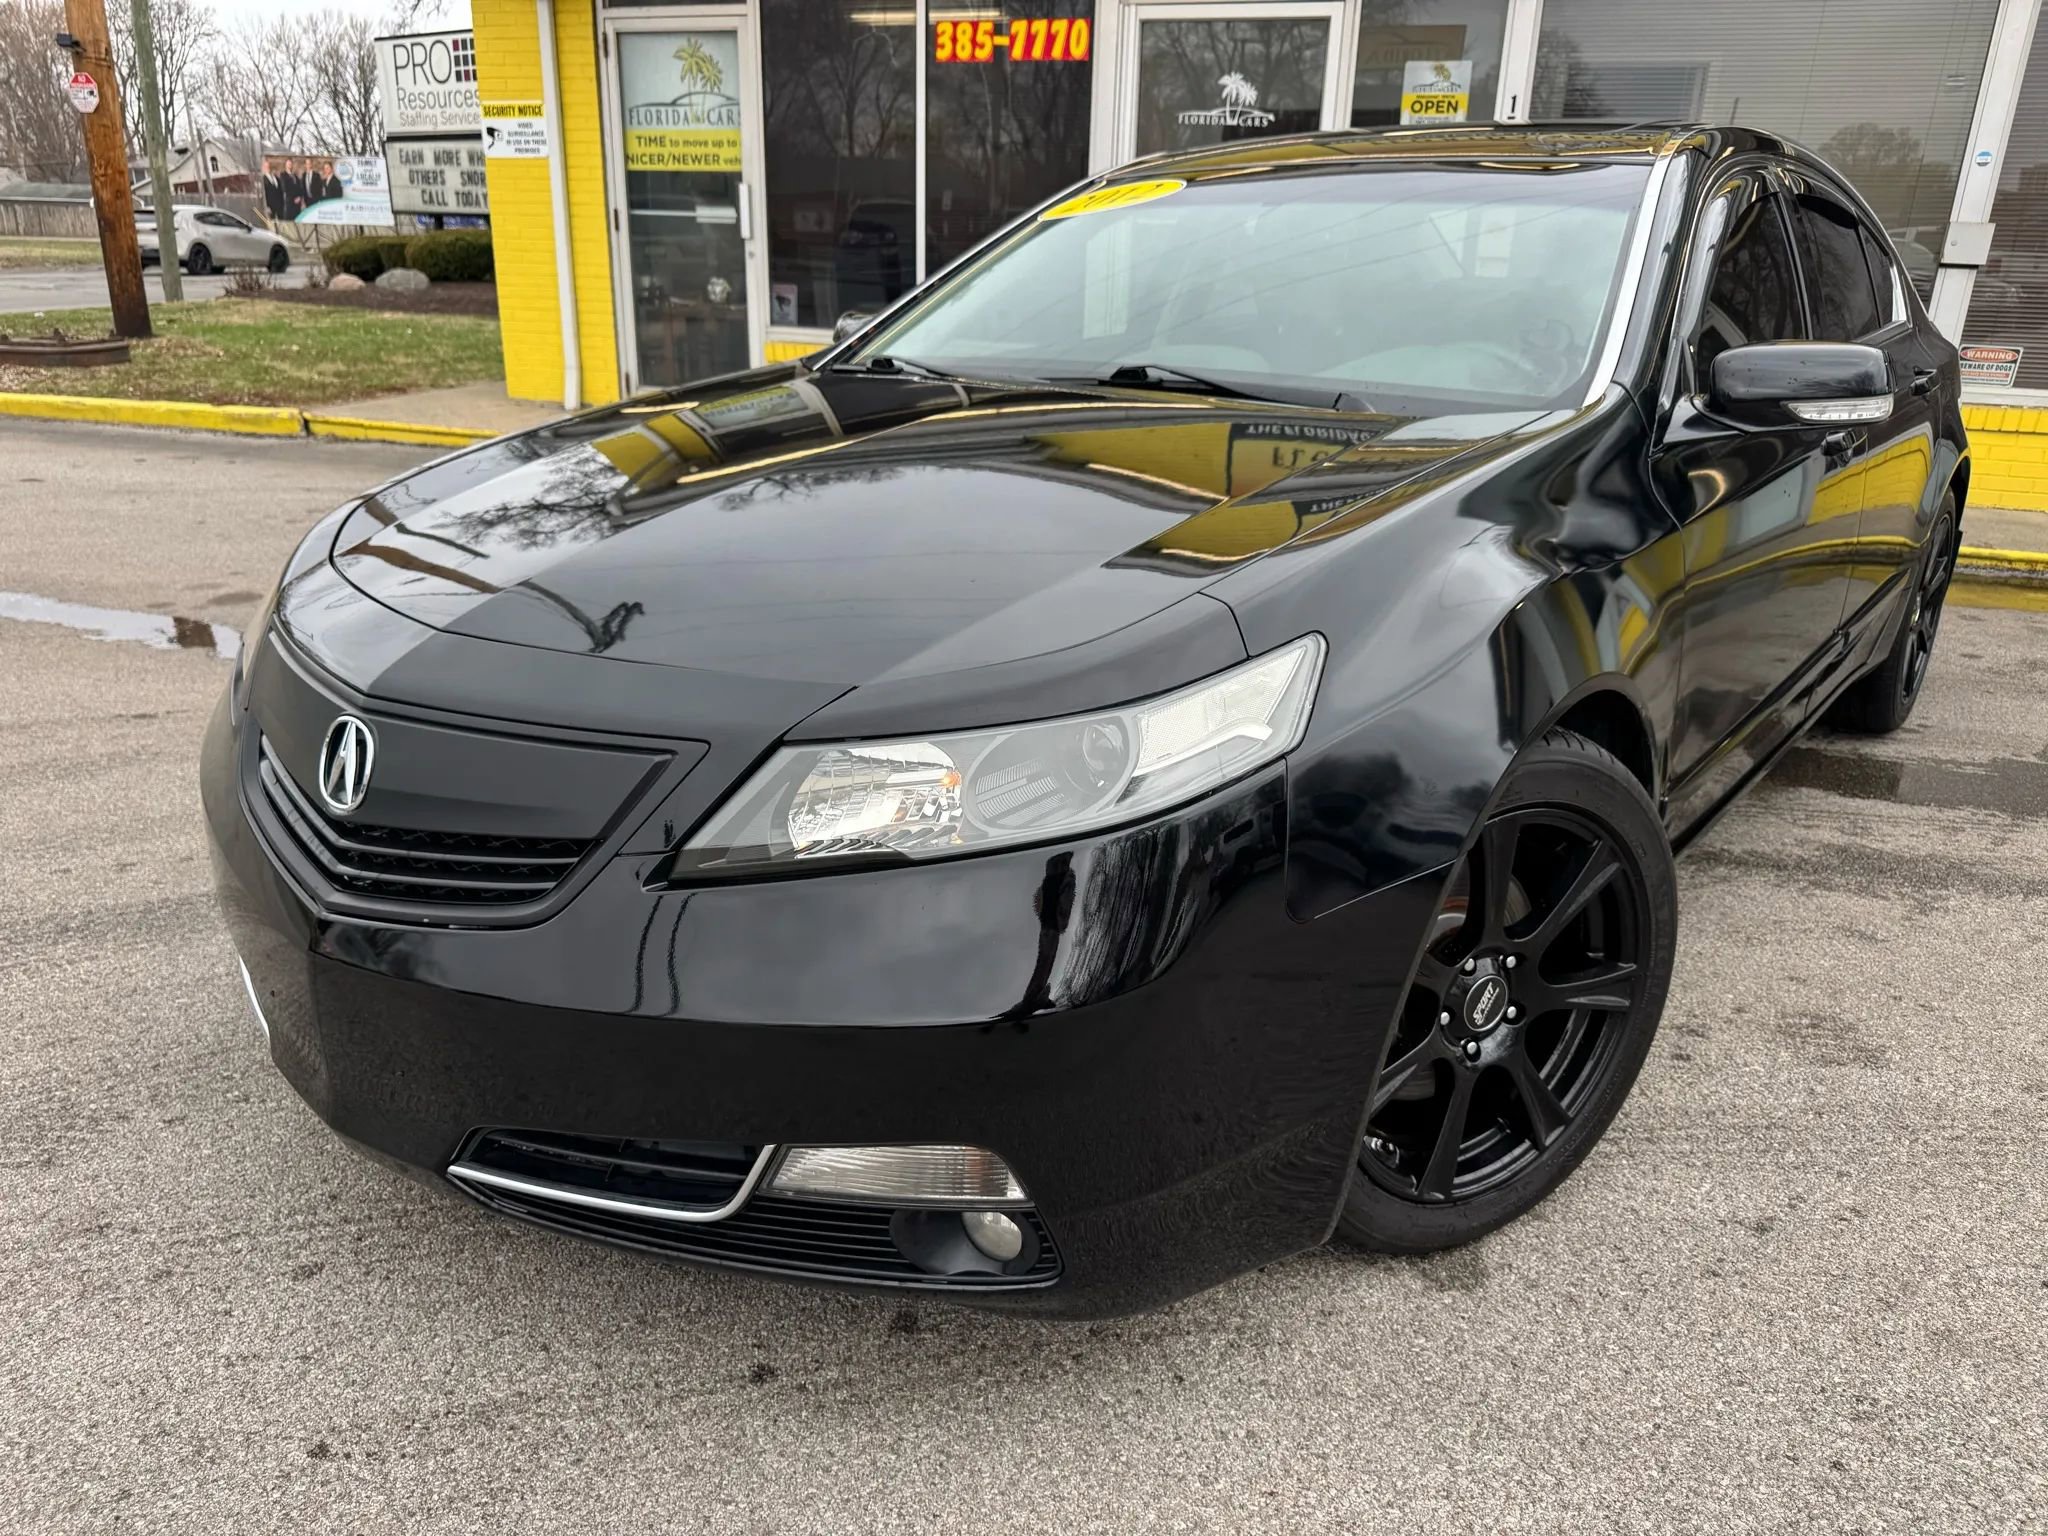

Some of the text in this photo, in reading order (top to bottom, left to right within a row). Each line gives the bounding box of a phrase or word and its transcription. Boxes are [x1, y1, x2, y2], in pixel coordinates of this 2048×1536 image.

[936, 19, 1090, 61] 385-7770
[393, 40, 452, 85] PRO
[397, 86, 480, 110] Resources
[1410, 100, 1459, 114] OPEN
[1511, 94, 1517, 114] 1
[483, 104, 543, 117] SECURITY NOTICE
[628, 108, 690, 126] FLORIDA
[400, 110, 480, 130] Staffing Service
[1178, 113, 1269, 128] FLORIDA CARS
[636, 136, 667, 148] TIME
[669, 138, 680, 147] to
[712, 140, 724, 149] up
[727, 139, 738, 148] to
[398, 148, 424, 166] EARN
[434, 148, 461, 166] MORE
[626, 153, 720, 166] NICER/NEWER
[408, 168, 446, 186] OTHERS
[421, 189, 489, 209] CALL TODAY
[1967, 350, 2014, 360] WARNING
[1986, 363, 1995, 371] OF
[1995, 364, 2013, 372] DOGS
[1473, 982, 1493, 1019] SPORT
